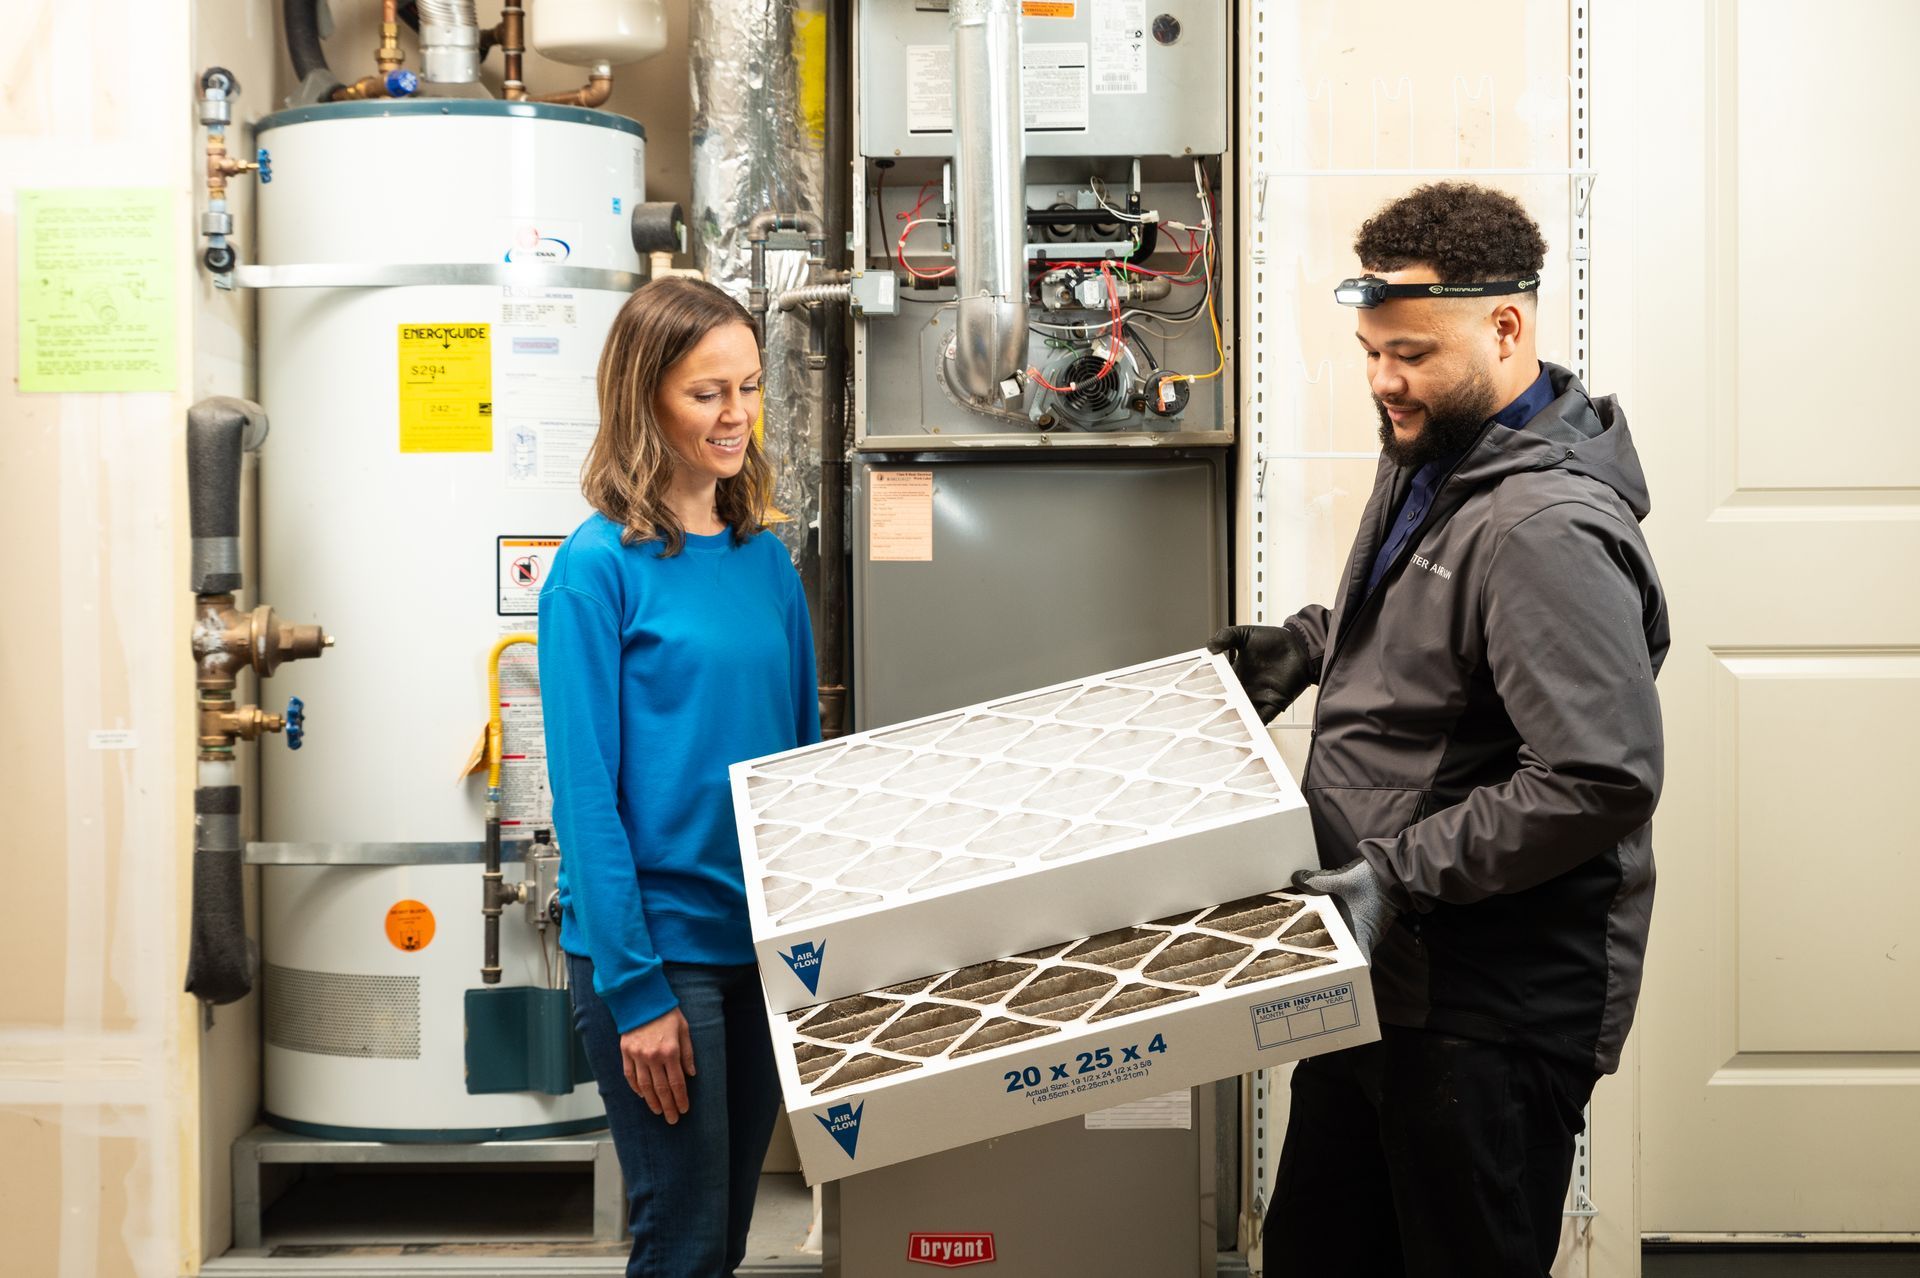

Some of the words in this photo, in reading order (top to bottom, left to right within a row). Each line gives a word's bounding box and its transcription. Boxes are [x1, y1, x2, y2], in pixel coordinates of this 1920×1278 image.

[403, 327, 486, 340] ENERGYGUIDE
[793, 957, 819, 970] FLOW
[797, 951, 813, 961] AIR
[1256, 1002, 1291, 1016] FILTER
[1293, 987, 1348, 1007] INSTALLED
[1260, 1010, 1285, 1020] MONTH
[1296, 1004, 1310, 1012] DAY
[1325, 996, 1344, 1005] YEAR
[1003, 1066, 1041, 1093] 20
[1049, 1063, 1069, 1082] x
[1076, 1047, 1113, 1074] 25
[1120, 1045, 1141, 1063] x
[1147, 1033, 1168, 1054] 4
[1026, 1086, 1049, 1098] Actual
[1050, 1082, 1069, 1092] Size:
[1071, 1078, 1081, 1086] 19
[1083, 1074, 1094, 1083] 1/2
[1102, 1070, 1111, 1079] 24
[1114, 1066, 1126, 1075] 1/2
[1140, 1060, 1152, 1068] 5/8
[1077, 1079, 1109, 1093] 62.25cm
[1116, 1070, 1144, 1082] 9.21cm
[830, 1119, 857, 1133] FLOW
[834, 1113, 851, 1124] AIR
[920, 1238, 983, 1260] bryant
